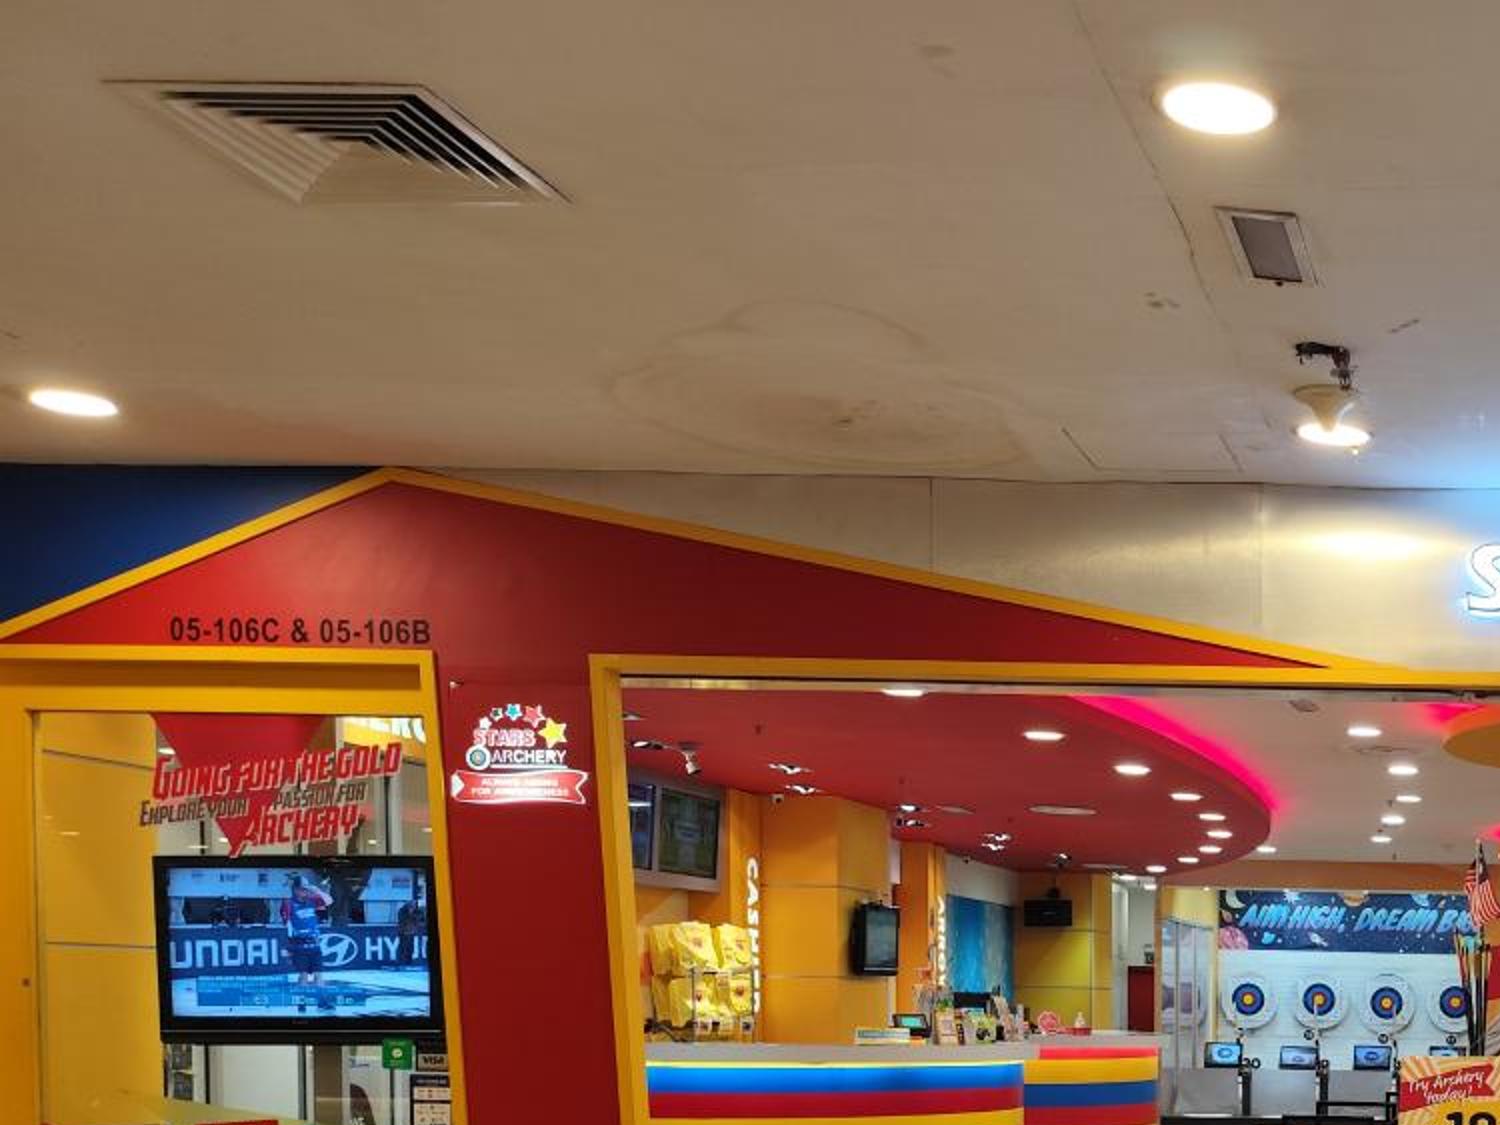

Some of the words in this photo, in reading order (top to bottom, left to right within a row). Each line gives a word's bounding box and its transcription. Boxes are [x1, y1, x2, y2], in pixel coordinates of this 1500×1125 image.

[169, 616, 280, 643] 05-106C
[291, 618, 310, 643] &
[319, 619, 431, 645] 05-106B
[472, 728, 537, 747] STARS
[490, 749, 567, 764] ARCHERY
[153, 757, 233, 801] GOING
[286, 750, 335, 787] THE
[336, 742, 402, 781] GOLD
[243, 804, 363, 848] ARCHERY
[1353, 907, 1439, 933] DREAM
[1407, 1080, 1429, 1094] Try
[1433, 1069, 1486, 1090] Archery
